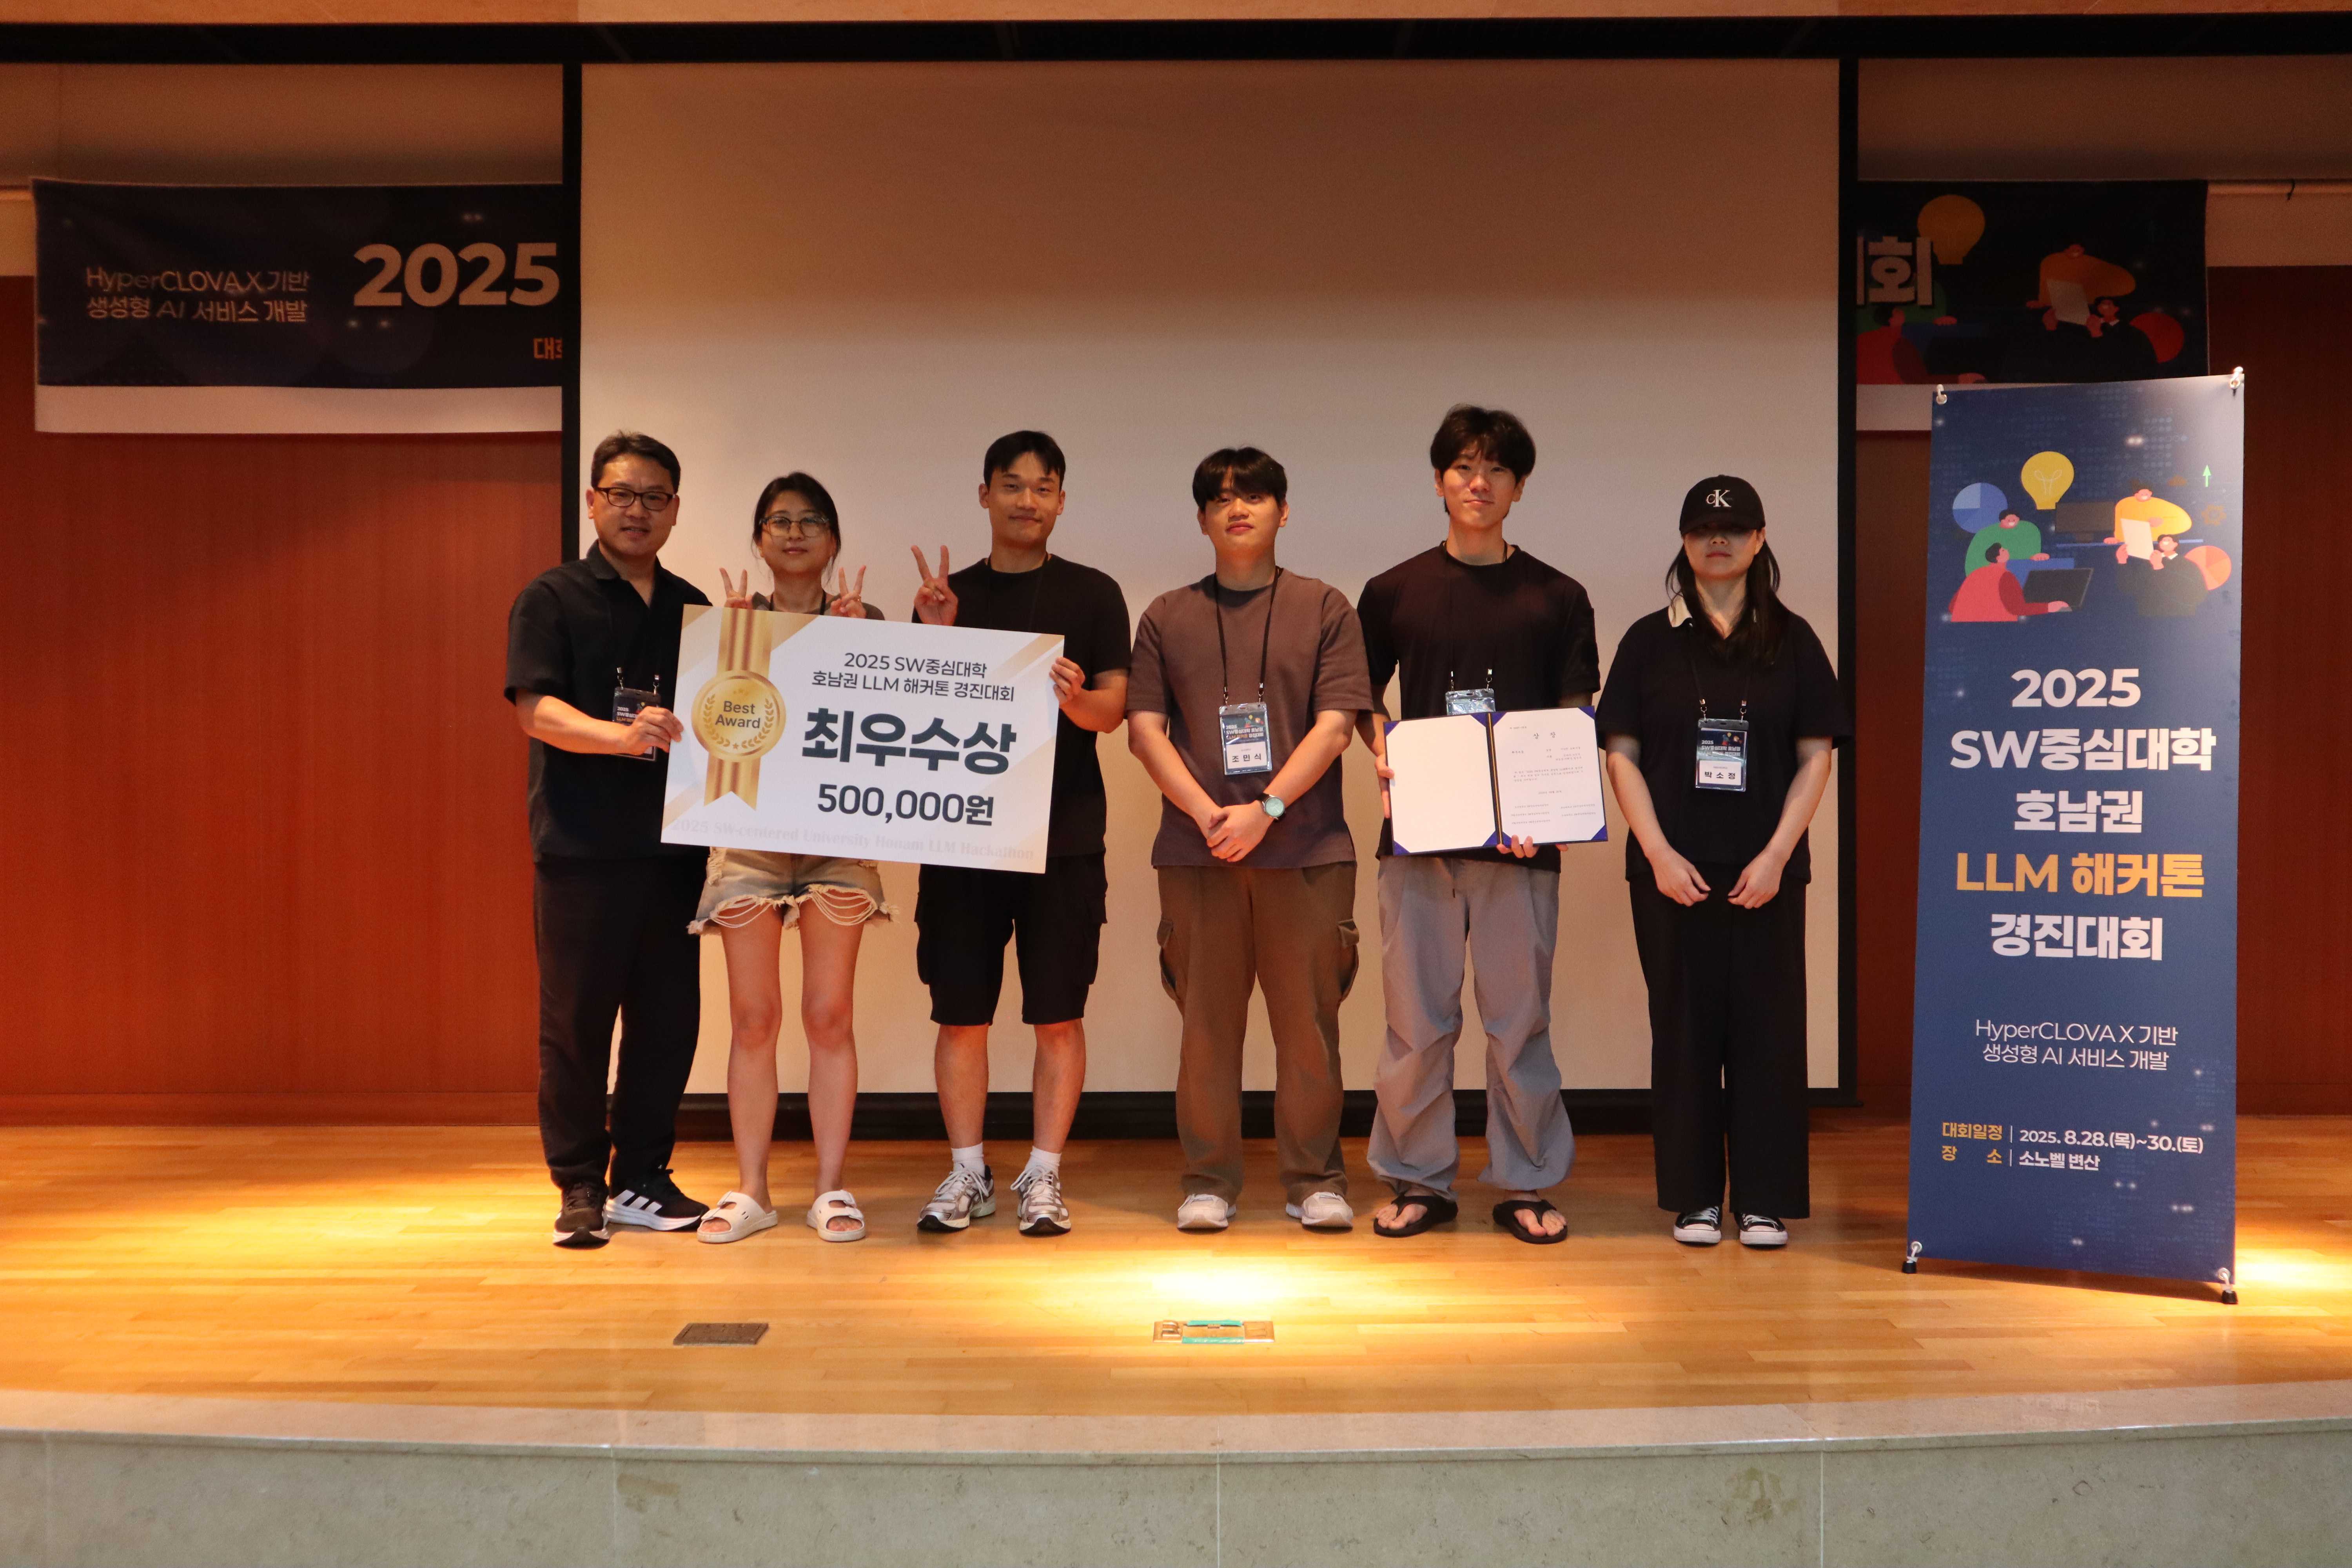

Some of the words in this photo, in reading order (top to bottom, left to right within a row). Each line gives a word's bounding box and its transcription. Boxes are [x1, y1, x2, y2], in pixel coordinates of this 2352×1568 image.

[267, 270, 310, 292] 기반
[354, 243, 559, 307] 2025
[1856, 236, 1933, 307] 회
[87, 296, 151, 319] 생성형
[157, 300, 185, 318] AI
[192, 300, 259, 323] 서비스
[263, 300, 308, 323] 개발
[844, 653, 890, 670] 2025
[895, 657, 987, 678] SW중심대학
[812, 670, 858, 689] 호남권
[863, 675, 899, 691] LLM
[904, 678, 949, 696] 해커톤
[955, 682, 1014, 702] 경진대회
[2012, 668, 2141, 707] 2025
[715, 714, 761, 729] Award
[723, 701, 755, 714] Best
[802, 708, 1017, 775] 최우수상
[1950, 728, 2217, 771] SW중심대학
[818, 784, 994, 826] 500,000원
[2014, 790, 2143, 833] 호남권
[671, 817, 709, 834] 2025
[1957, 853, 2058, 892] LLM
[2072, 853, 2204, 897] 해커톤
[1991, 914, 2163, 960] 경진대회
[2139, 1026, 2178, 1045] 기반
[1983, 1044, 2037, 1064] 생성형
[2042, 1047, 2062, 1065] AI
[2068, 1048, 2125, 1067] 서비스
[2130, 1051, 2169, 1070] 개발
[1942, 1122, 2002, 1140] 대회일정
[2020, 1130, 2061, 1144] 2025.
[1942, 1145, 1957, 1161] 장
[1987, 1149, 2002, 1163] 소
[2019, 1151, 2065, 1169] 소노벨
[2069, 1154, 2100, 1171] 변산
